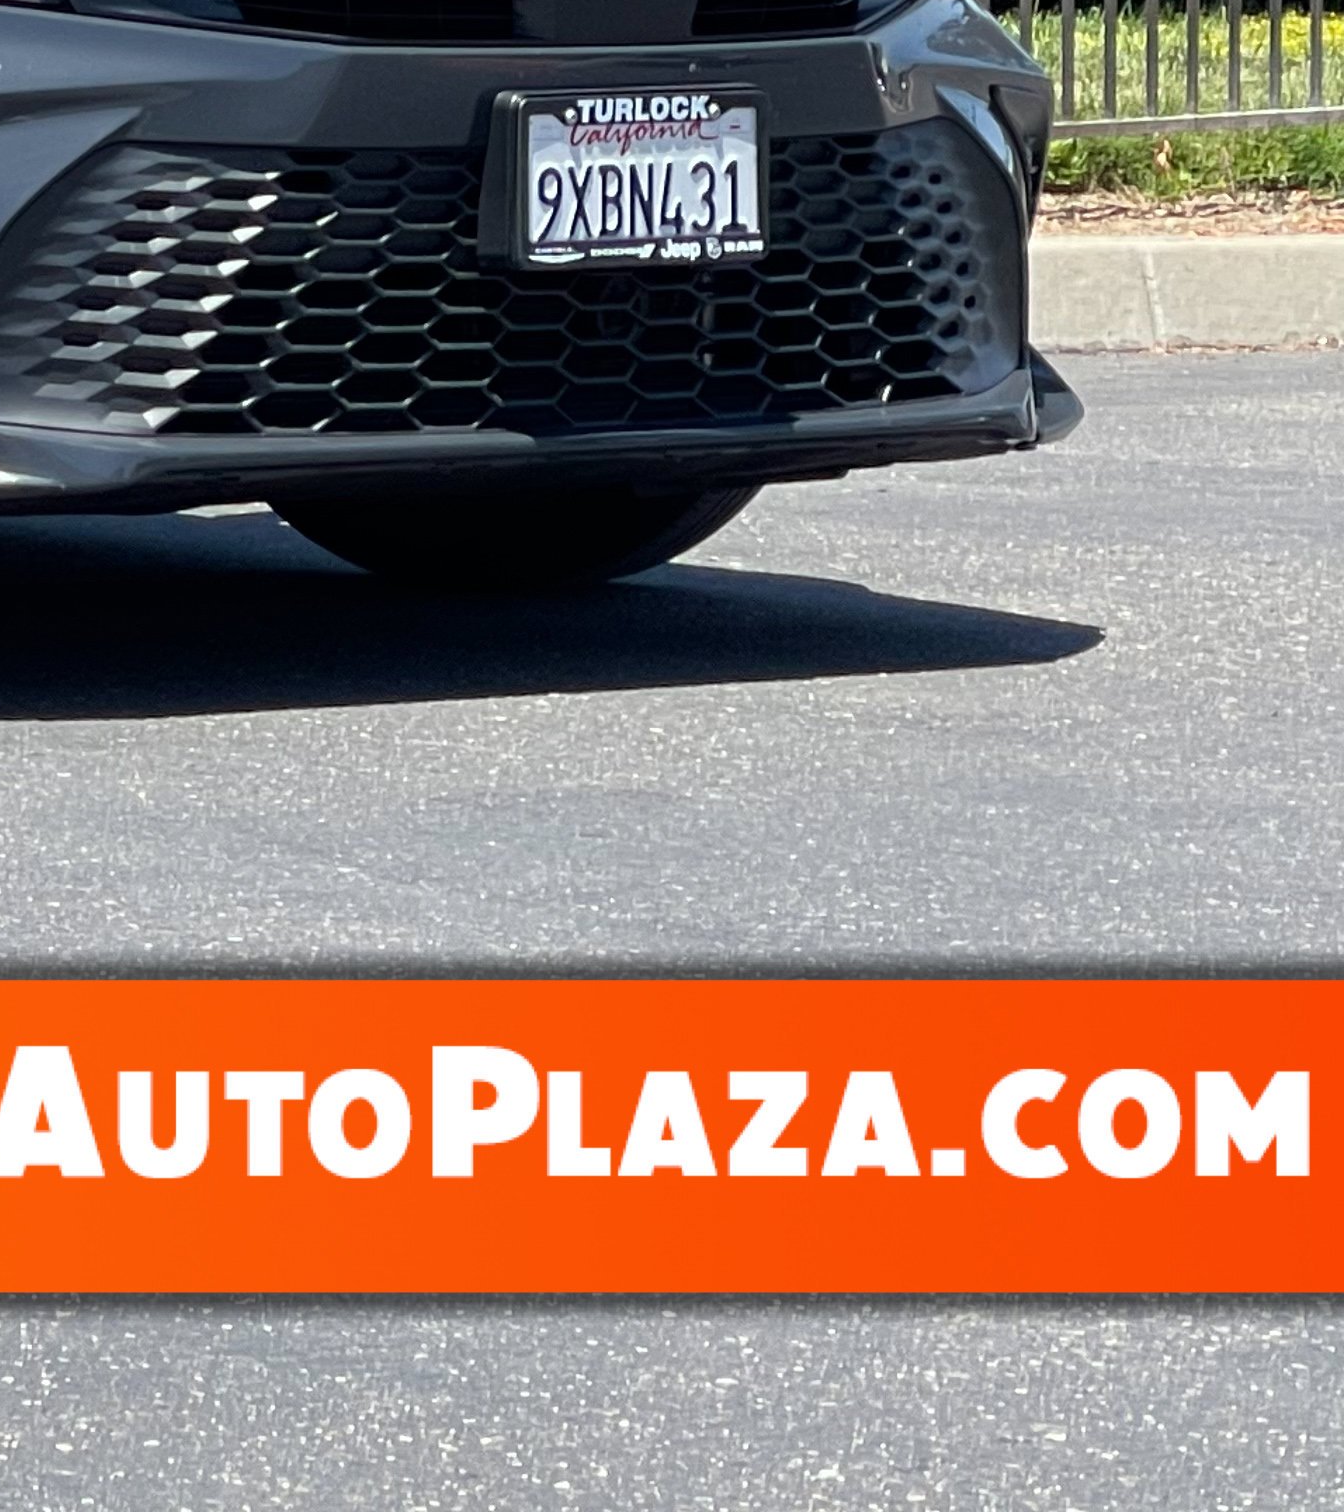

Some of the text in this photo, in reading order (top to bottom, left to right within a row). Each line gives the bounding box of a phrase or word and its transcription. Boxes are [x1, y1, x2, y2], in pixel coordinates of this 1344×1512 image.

[576, 94, 711, 123] TURLOCK
[537, 159, 749, 243] 9XBN431
[660, 239, 701, 261] Jeep
